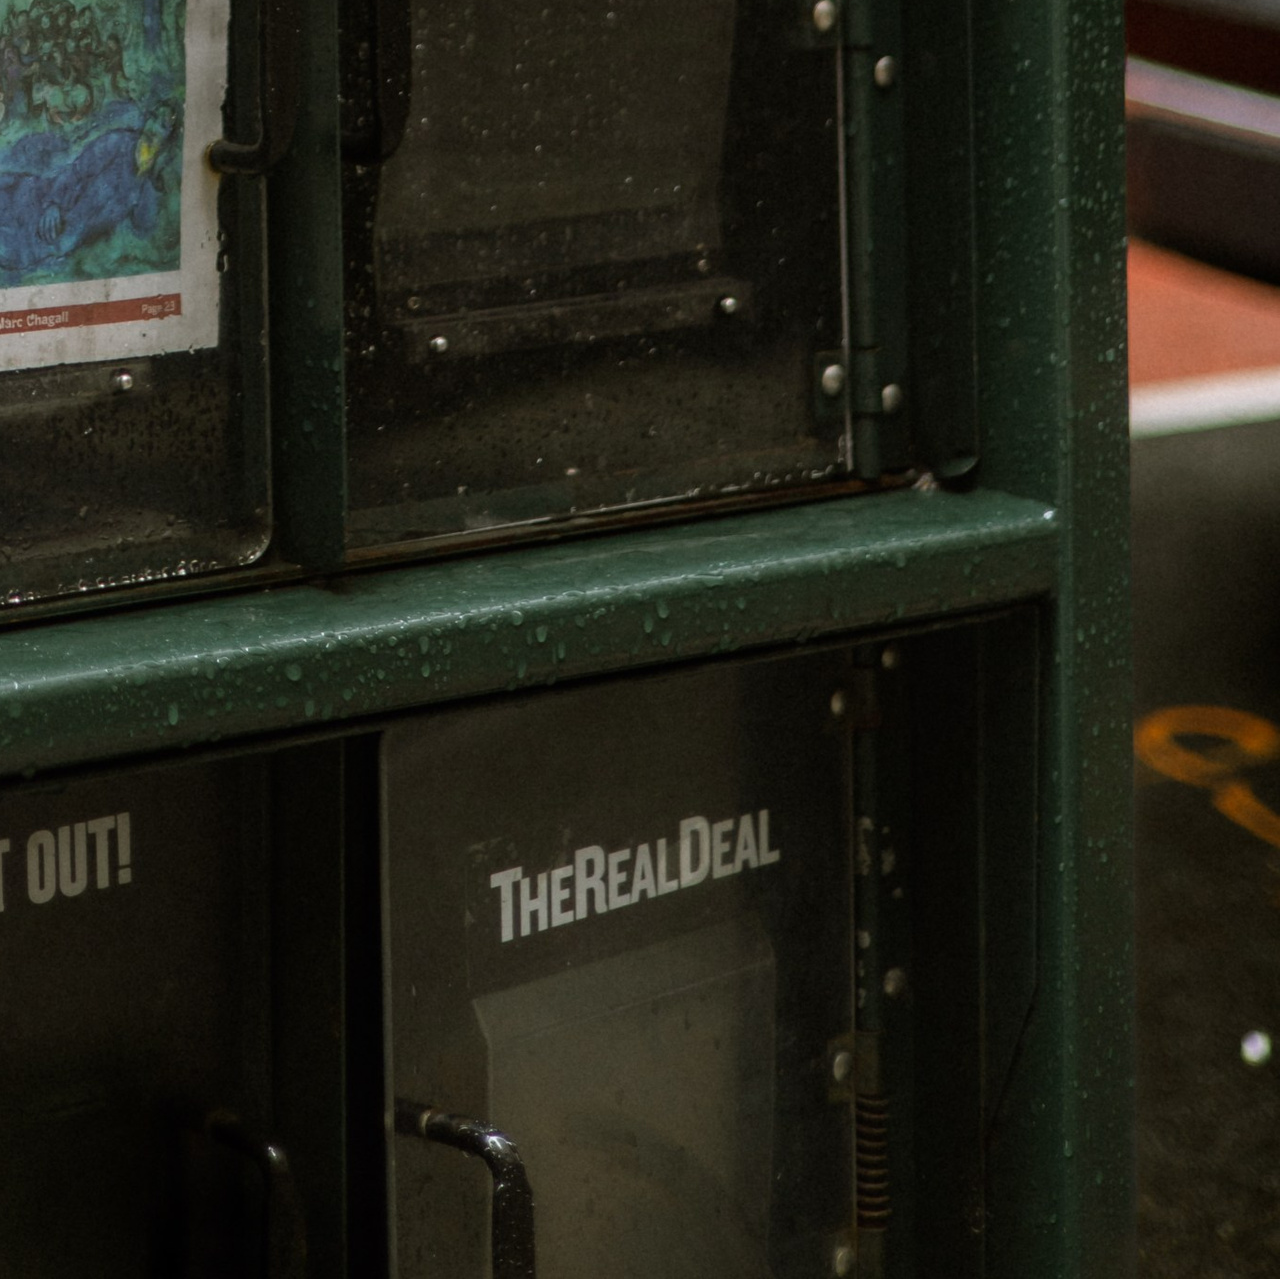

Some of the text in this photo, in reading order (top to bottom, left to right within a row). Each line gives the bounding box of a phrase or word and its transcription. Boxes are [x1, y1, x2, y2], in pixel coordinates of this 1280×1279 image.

[141, 303, 162, 316] Page
[26, 311, 69, 328] Chagall
[26, 811, 132, 904] OUT!
